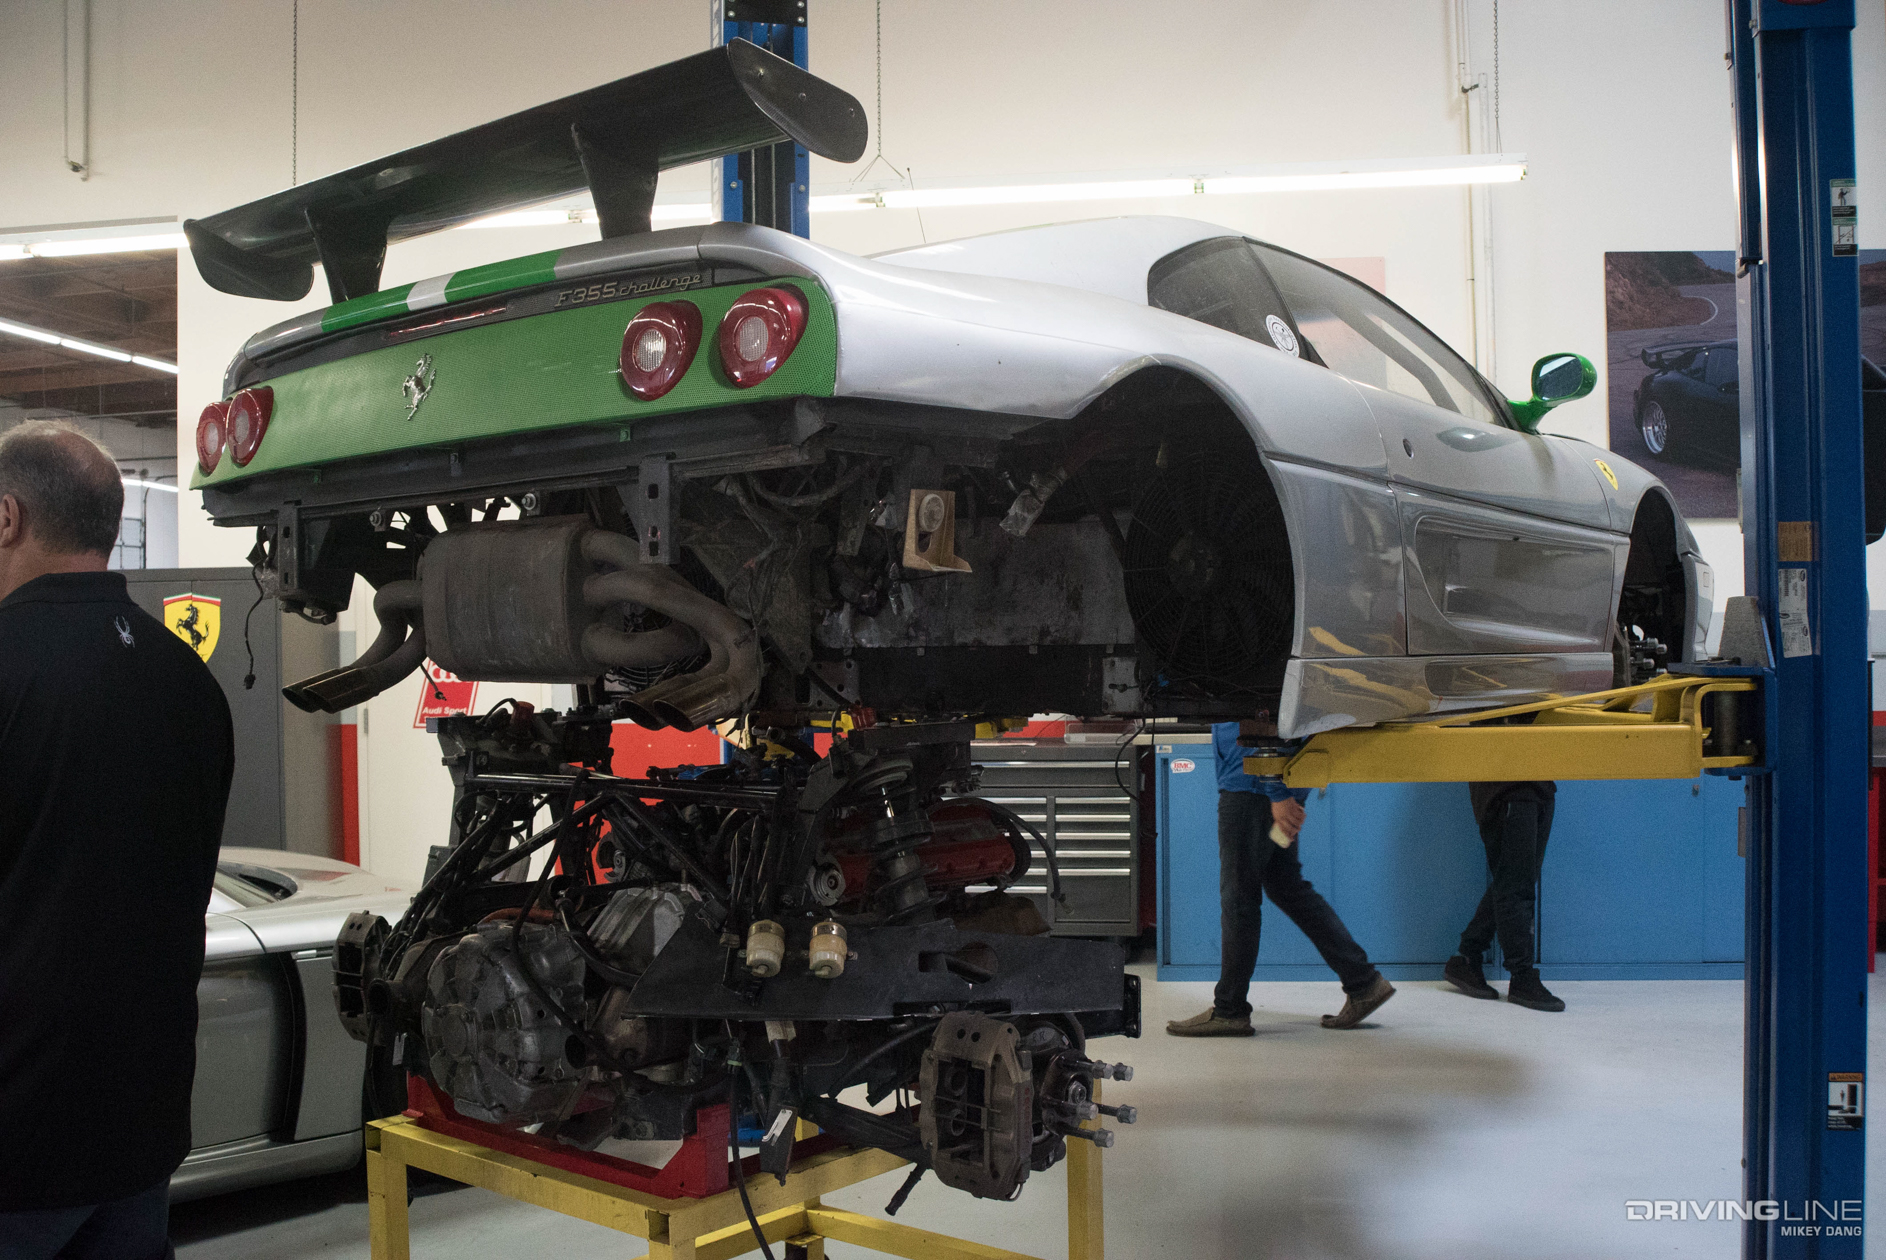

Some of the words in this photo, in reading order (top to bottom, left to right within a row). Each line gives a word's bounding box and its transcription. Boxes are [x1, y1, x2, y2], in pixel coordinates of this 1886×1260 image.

[554, 281, 618, 307] F355
[619, 274, 701, 296] challenge
[422, 706, 443, 715] Audi
